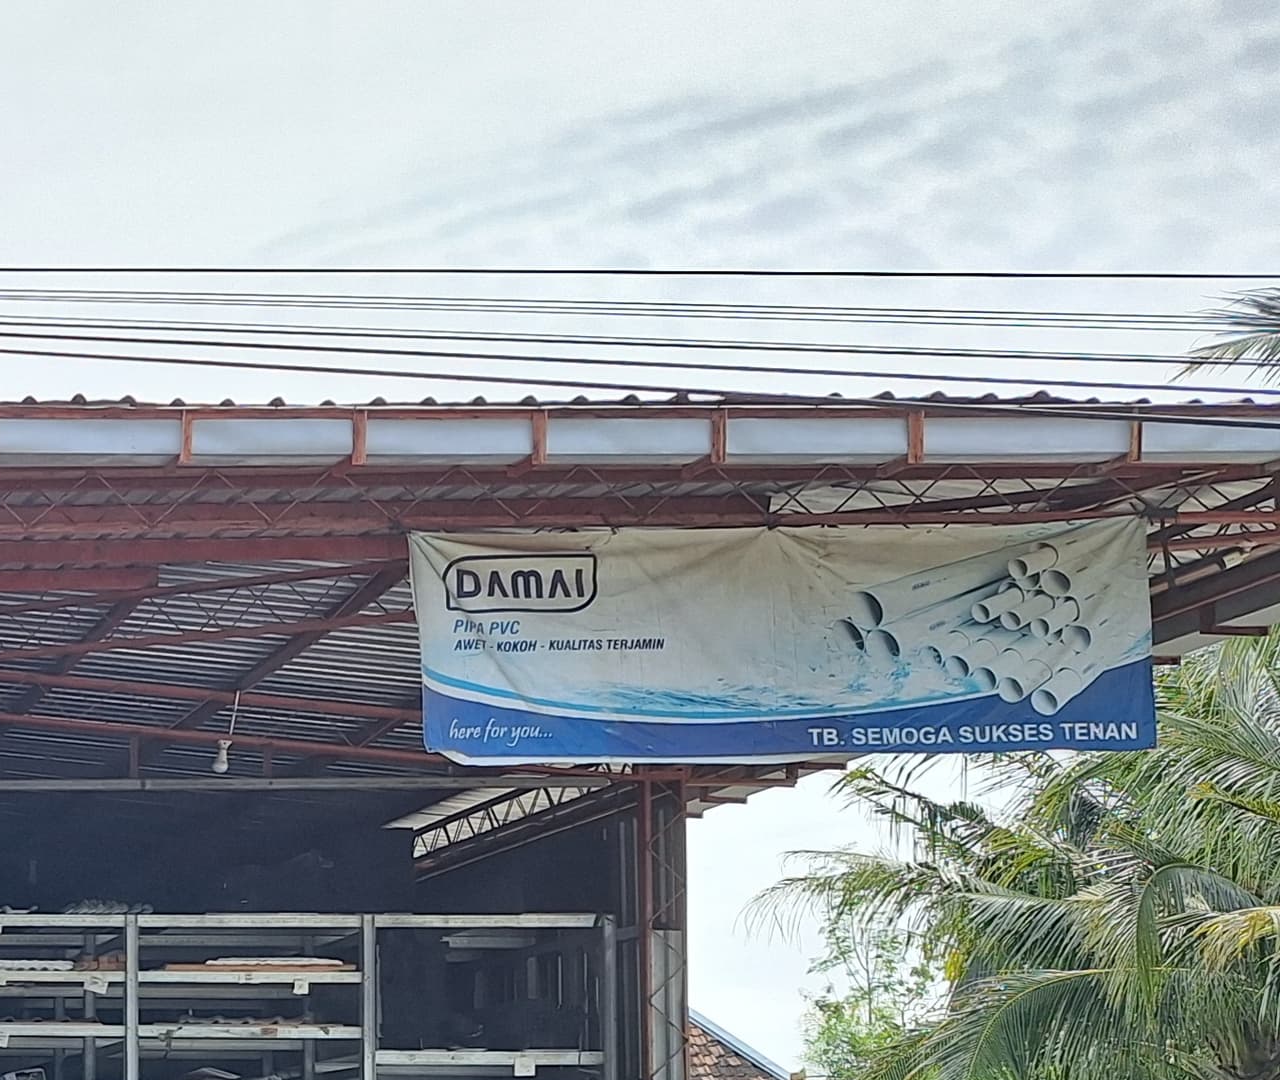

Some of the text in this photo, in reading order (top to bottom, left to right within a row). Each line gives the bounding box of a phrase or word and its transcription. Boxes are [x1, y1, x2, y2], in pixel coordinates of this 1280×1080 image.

[455, 568, 586, 599] DAMAI
[453, 619, 521, 635] PIPA PVC
[454, 638, 487, 651] AWET
[496, 639, 538, 653] KOKOH
[548, 638, 603, 652] KUALITAS
[606, 637, 665, 651] TERJAMIN
[449, 717, 554, 747] here for you...
[808, 722, 1138, 746] TB. SEMOGA SUKSES TENAN
